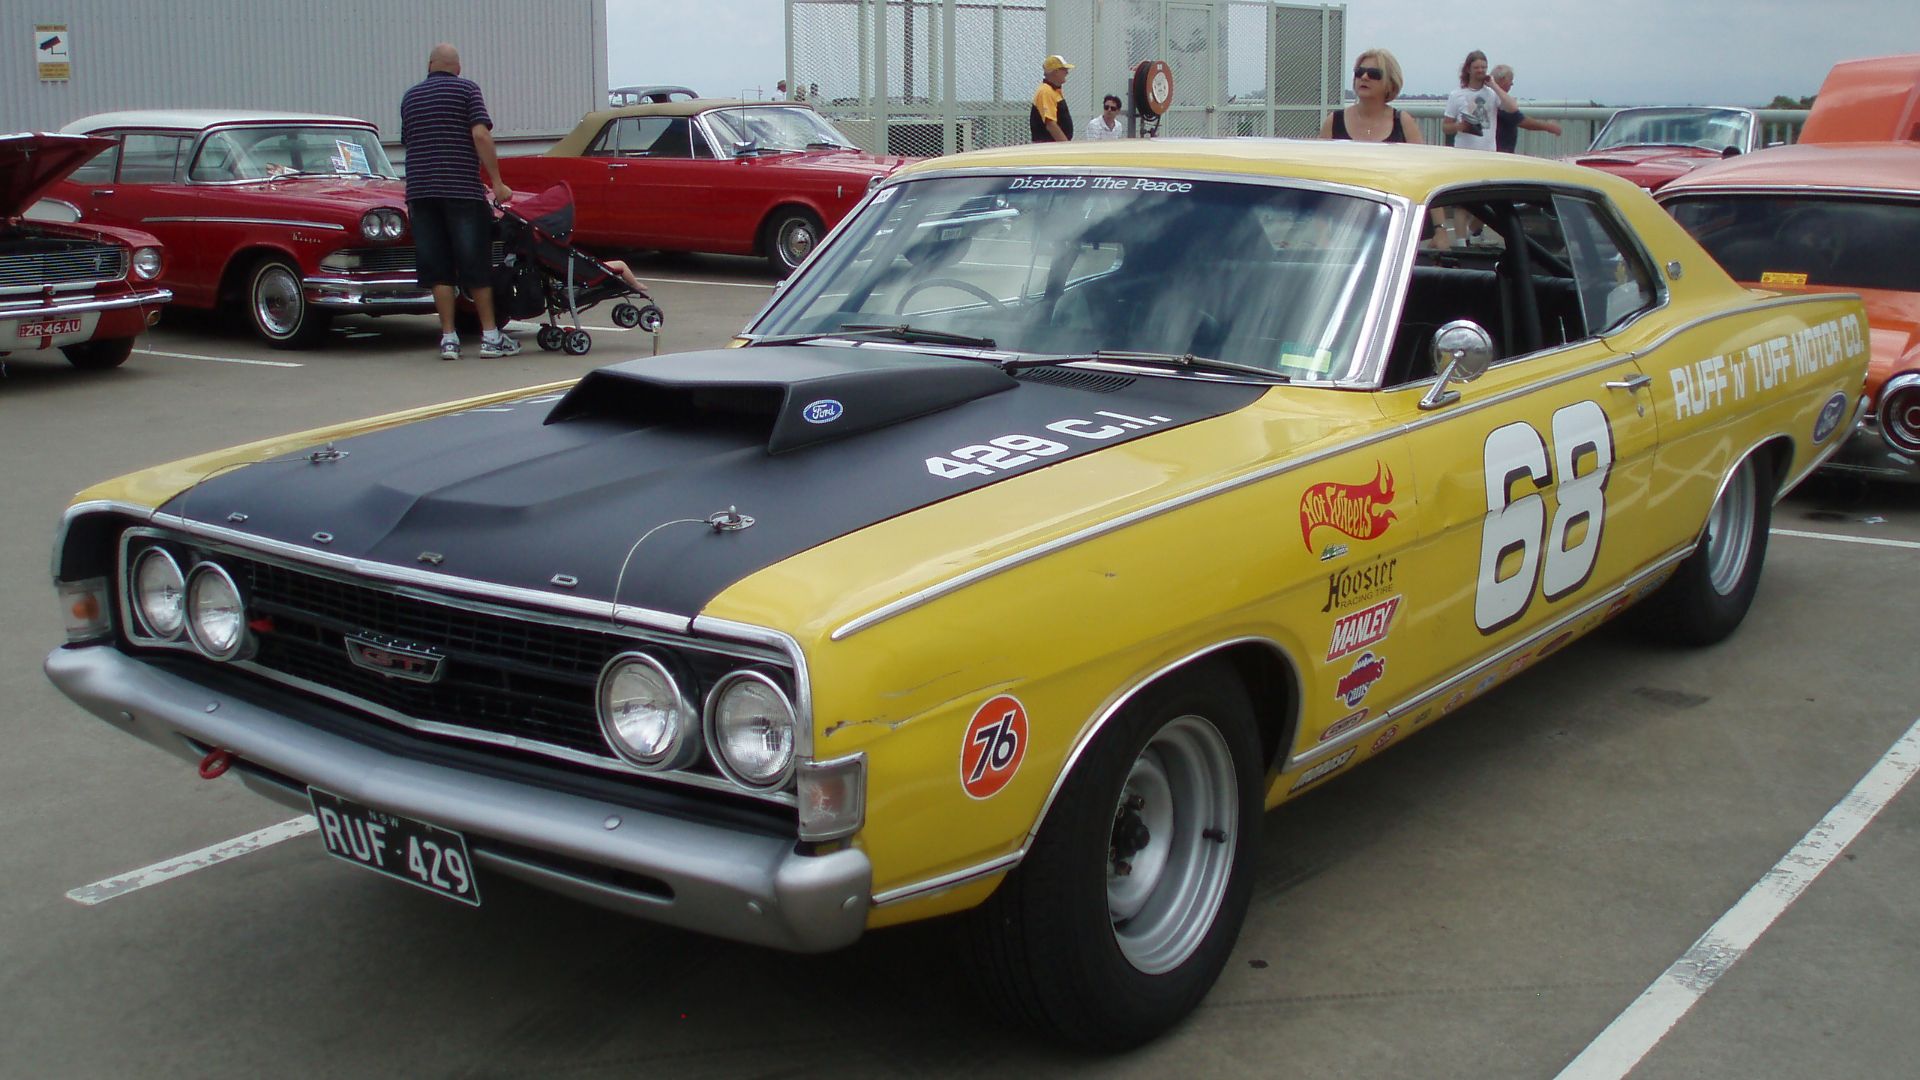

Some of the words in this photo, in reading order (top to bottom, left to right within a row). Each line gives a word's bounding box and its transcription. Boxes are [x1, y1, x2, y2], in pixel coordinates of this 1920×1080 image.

[1009, 176, 1086, 190] Disturb
[1091, 177, 1128, 190] The
[1132, 178, 1192, 193] Peace
[1670, 355, 1728, 421] RUFF
[1748, 336, 1790, 392] TUFF
[1792, 320, 1843, 378] MOTOR
[1841, 313, 1864, 358] CO.
[812, 403, 836, 420] Ford
[925, 434, 1069, 479] 429
[1046, 410, 1172, 439] C.I.
[1474, 400, 1616, 636] 68
[1321, 554, 1397, 613] Hoosier
[1340, 591, 1374, 608] RACING
[1376, 583, 1393, 596] TIRE
[1329, 604, 1392, 655] MANLEY
[967, 709, 1018, 784] 76
[368, 809, 400, 828] NSW
[319, 806, 387, 867] RUF
[408, 835, 469, 894] 429
